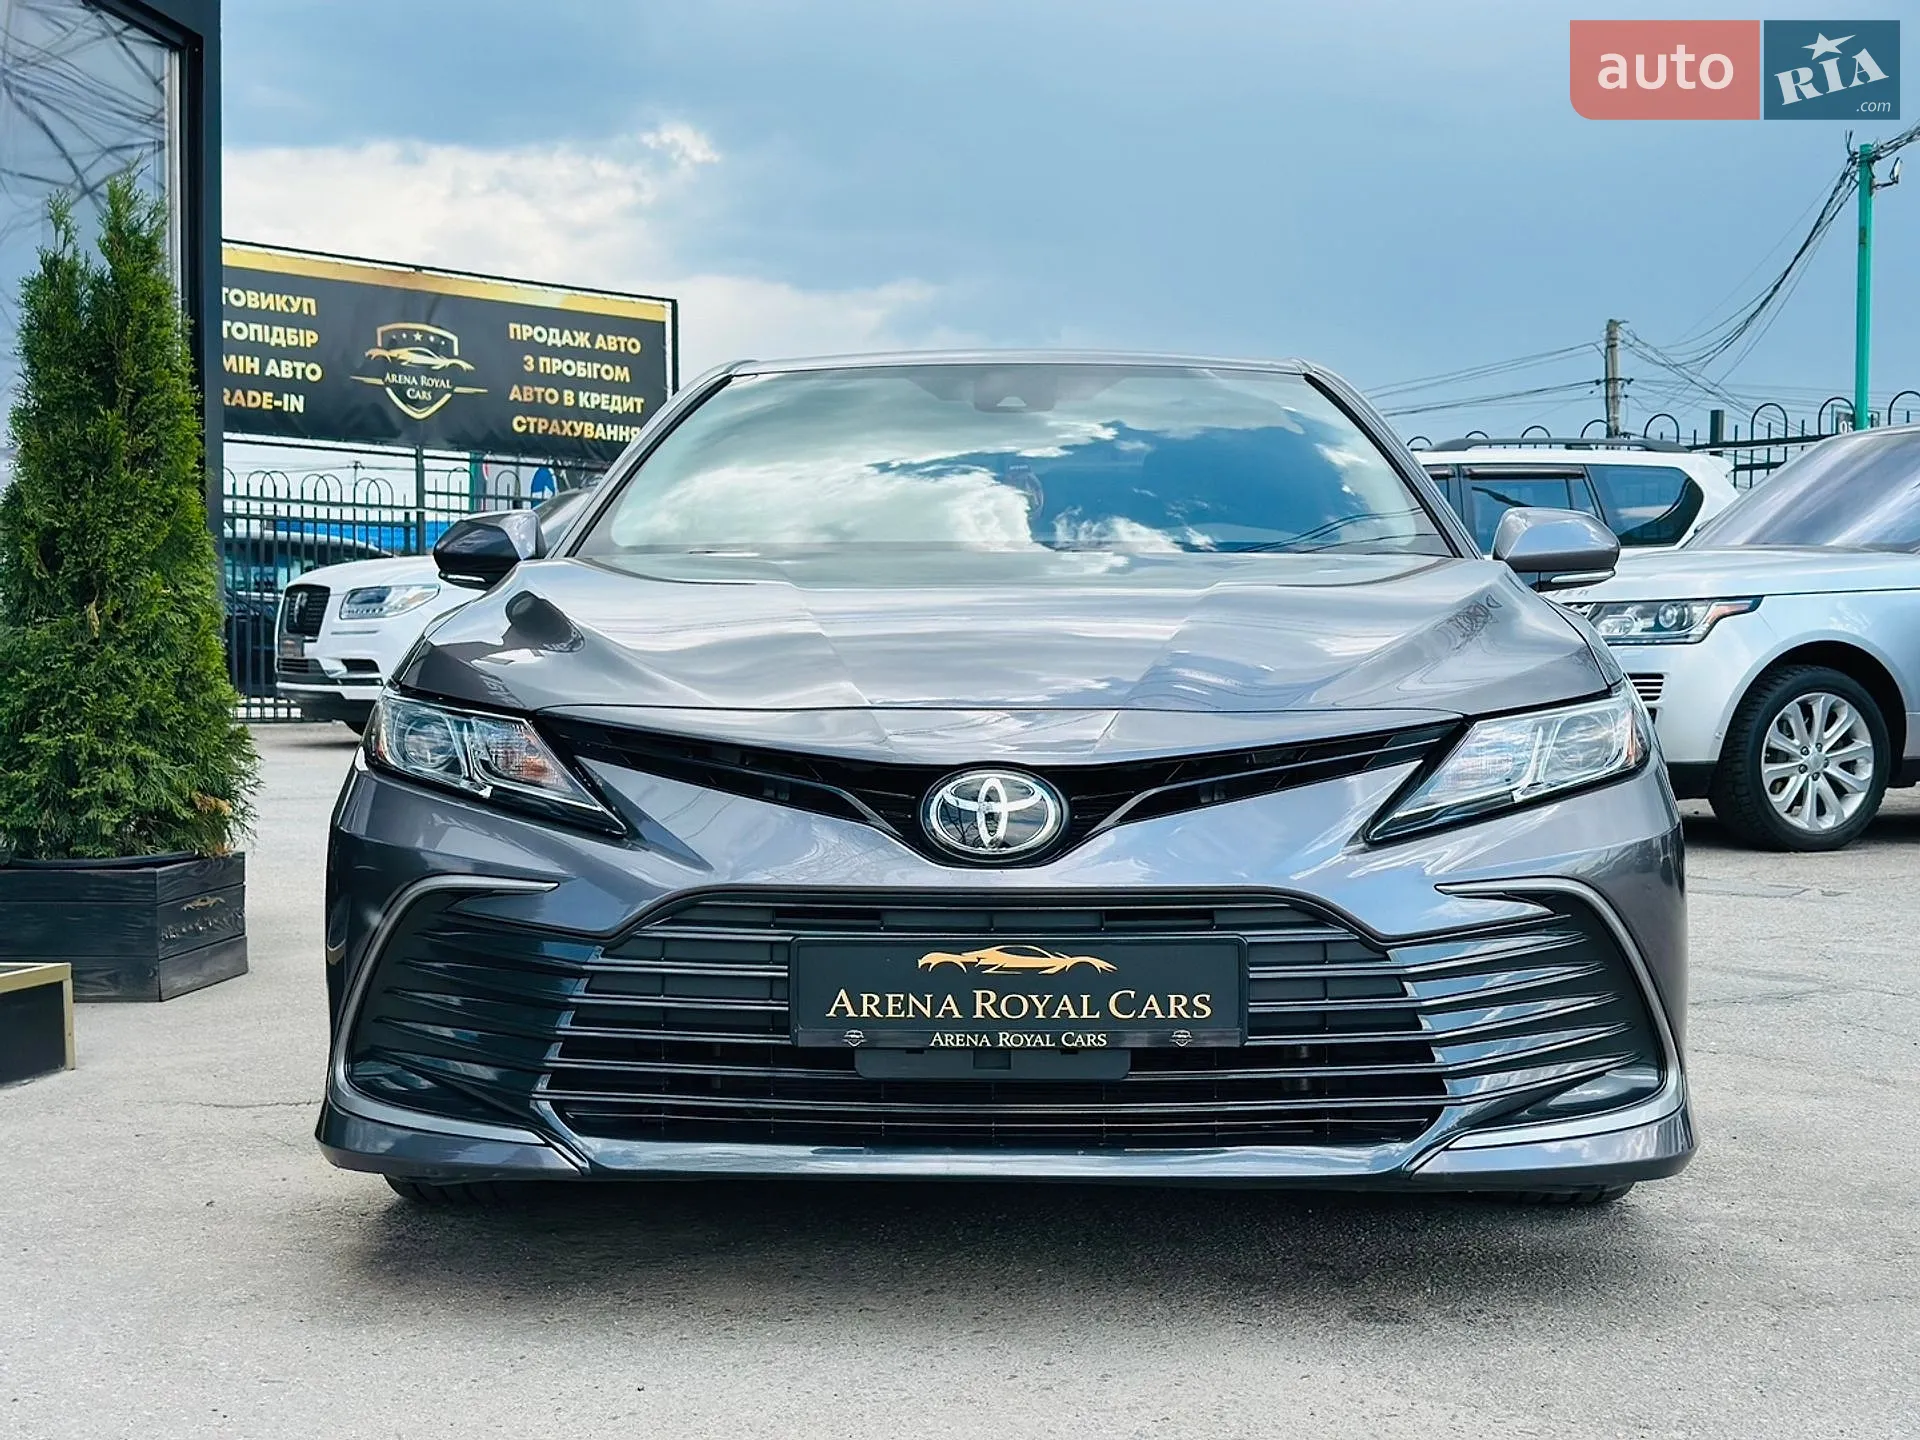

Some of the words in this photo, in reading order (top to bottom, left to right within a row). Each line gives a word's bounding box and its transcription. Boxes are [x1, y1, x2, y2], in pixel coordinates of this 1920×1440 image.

[508, 322, 591, 348] ПРОДАЖ
[594, 333, 642, 354] АВТО
[265, 358, 323, 382] АВТО
[384, 371, 418, 386] ARENA
[421, 374, 453, 389] ROYAL
[538, 356, 631, 383] ПРОБІГОМ
[406, 387, 432, 401] CARS
[508, 384, 560, 405] АВТО
[563, 389, 575, 407] В
[578, 390, 645, 414] КРЕДИТ
[511, 415, 641, 442] СТРАХУВАННЯ
[826, 988, 963, 1019] ARENA
[972, 989, 1100, 1020] ROYAL
[1108, 989, 1212, 1020] CARS
[929, 1031, 991, 1047] ARENA
[998, 1031, 1056, 1048] ROYAL
[1061, 1031, 1107, 1047] CARS
